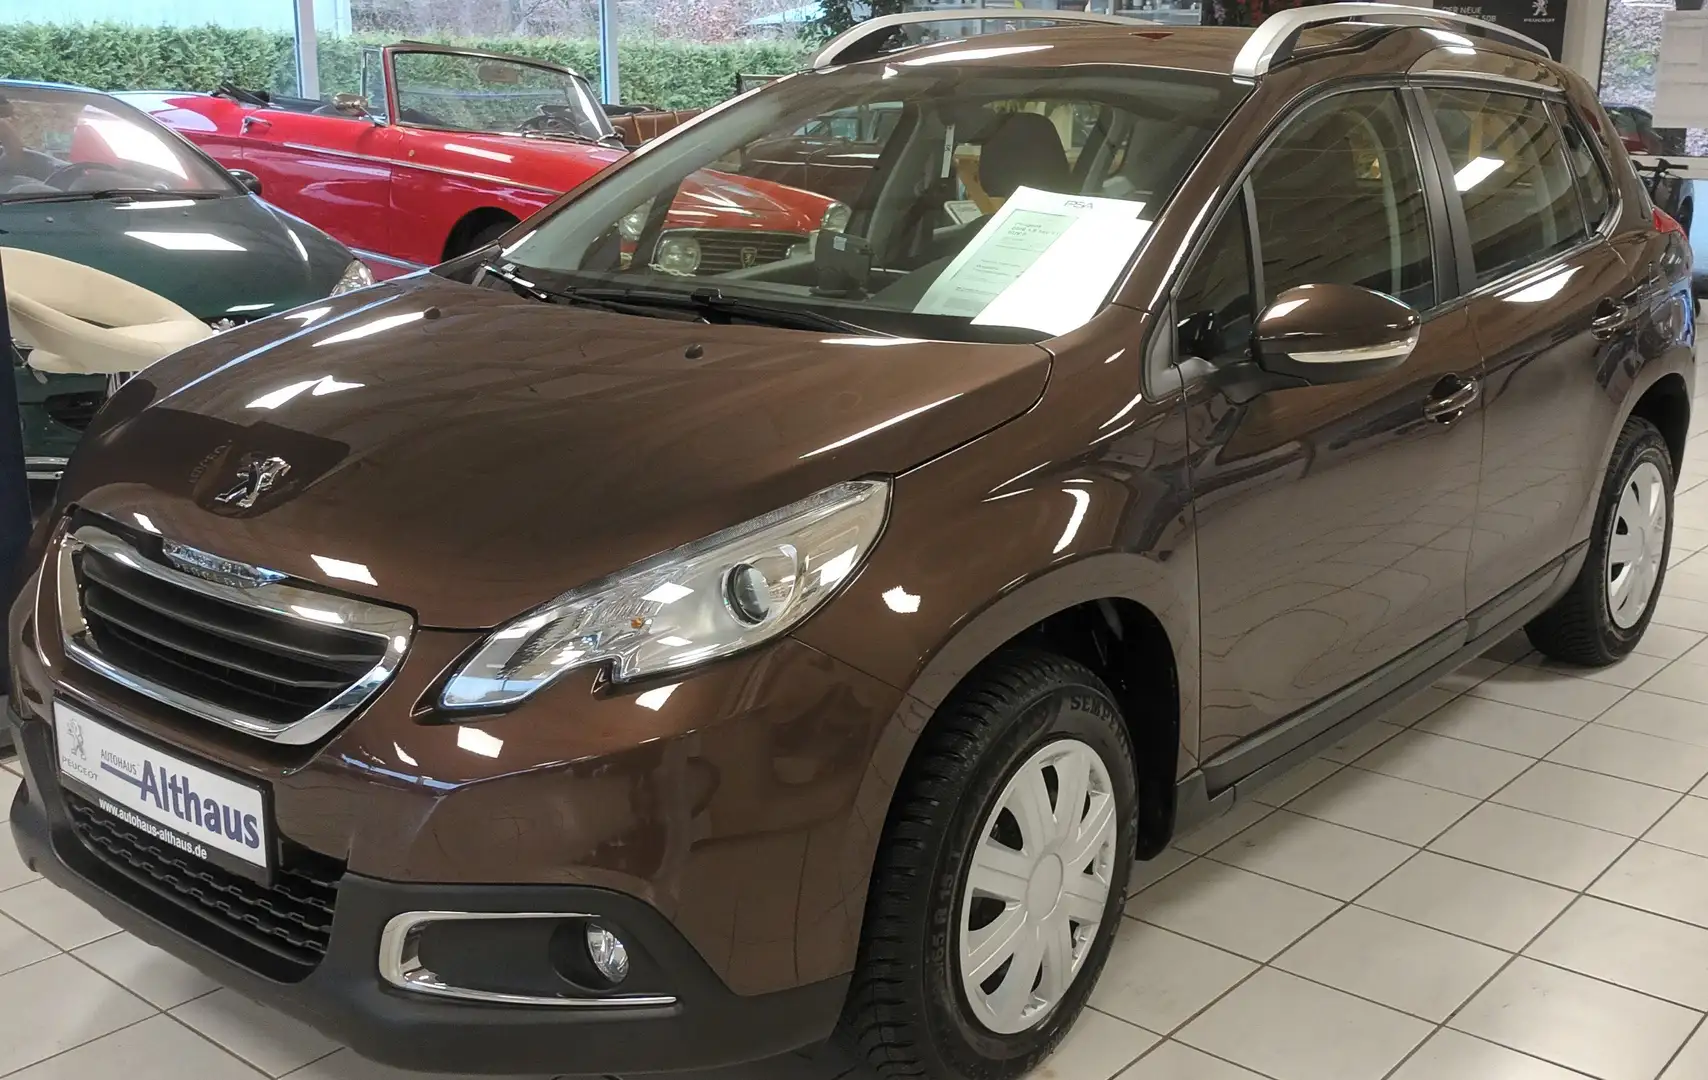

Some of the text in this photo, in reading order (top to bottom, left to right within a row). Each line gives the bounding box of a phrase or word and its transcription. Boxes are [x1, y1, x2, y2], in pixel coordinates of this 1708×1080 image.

[1460, 6, 1482, 14] NEUE
[1064, 200, 1093, 209] PSA
[61, 756, 99, 781] PEUGEOT
[100, 748, 138, 775] AUTOHAUS
[140, 759, 261, 850] Althaus
[98, 797, 208, 860] www.autohaus-althaus.de
